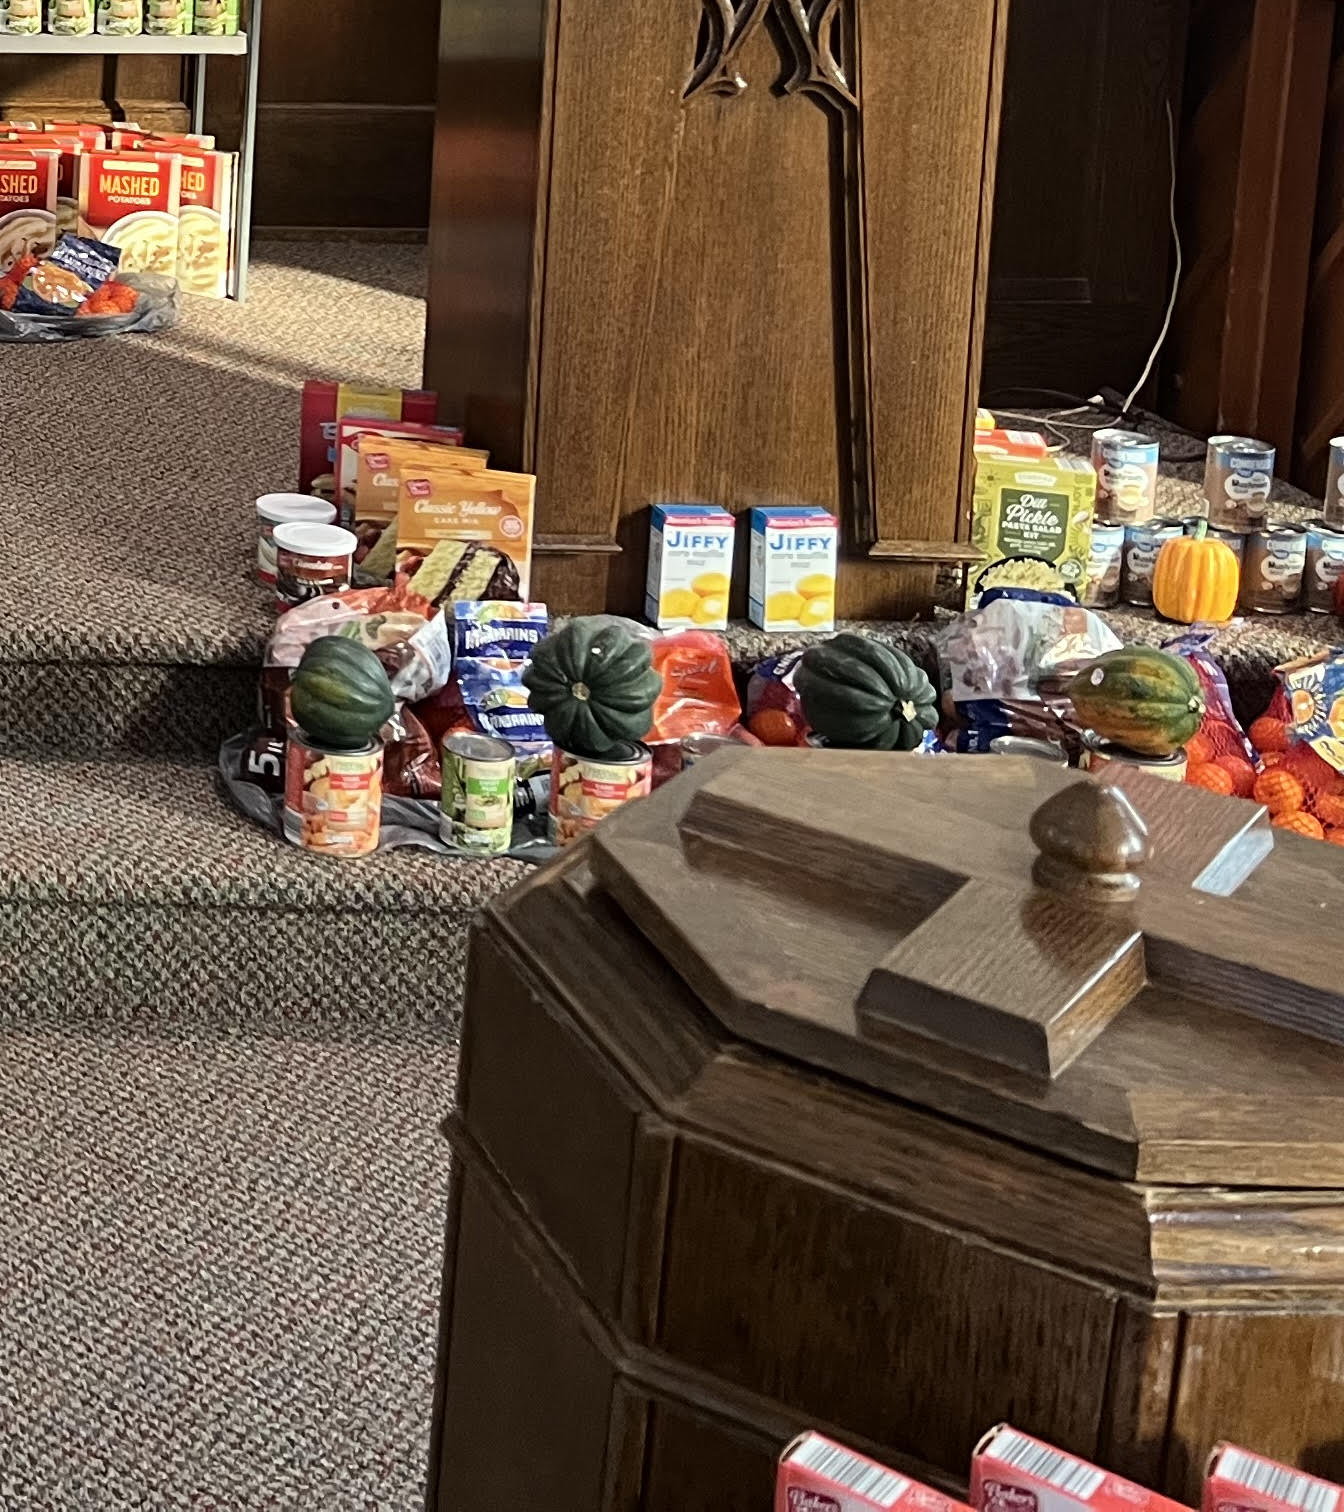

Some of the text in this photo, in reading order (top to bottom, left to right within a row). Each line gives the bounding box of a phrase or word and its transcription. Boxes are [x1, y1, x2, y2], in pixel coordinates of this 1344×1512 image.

[99, 175, 160, 197] MASHED
[108, 195, 151, 206] POTATOES
[372, 473, 399, 487] Clas
[414, 499, 502, 517] Classic Yellow
[1020, 494, 1047, 509] Dill
[433, 517, 459, 525] CAKE
[1006, 504, 1059, 526] Pickle
[1002, 521, 1062, 534] PASTA SALAD
[1023, 531, 1040, 539] KIT
[667, 531, 729, 549] JIFFY
[770, 534, 832, 551] JIFFY
